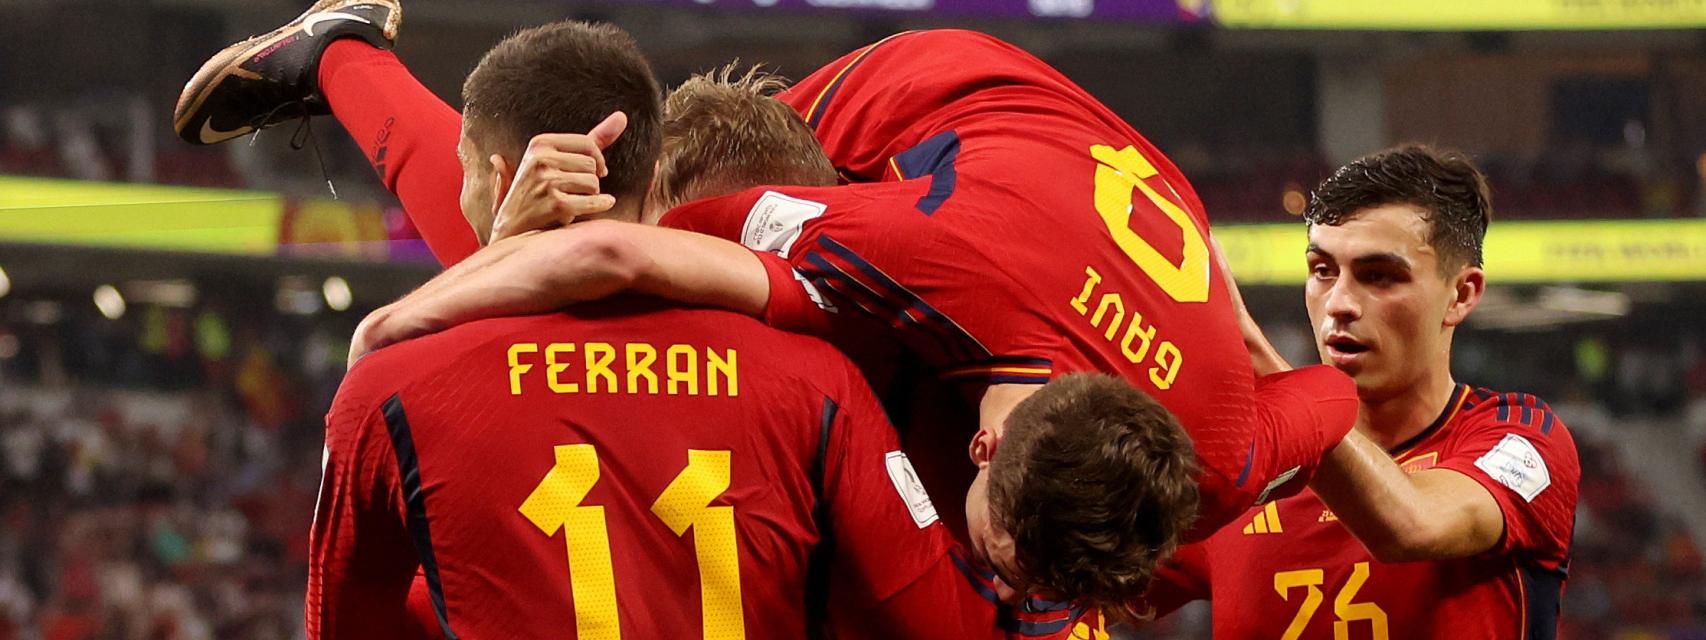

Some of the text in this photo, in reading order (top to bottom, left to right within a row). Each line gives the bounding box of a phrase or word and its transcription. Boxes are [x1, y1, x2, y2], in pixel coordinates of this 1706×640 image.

[507, 342, 738, 396] FERRAN
[1070, 266, 1183, 390] GAVI
[518, 443, 746, 640] 11
